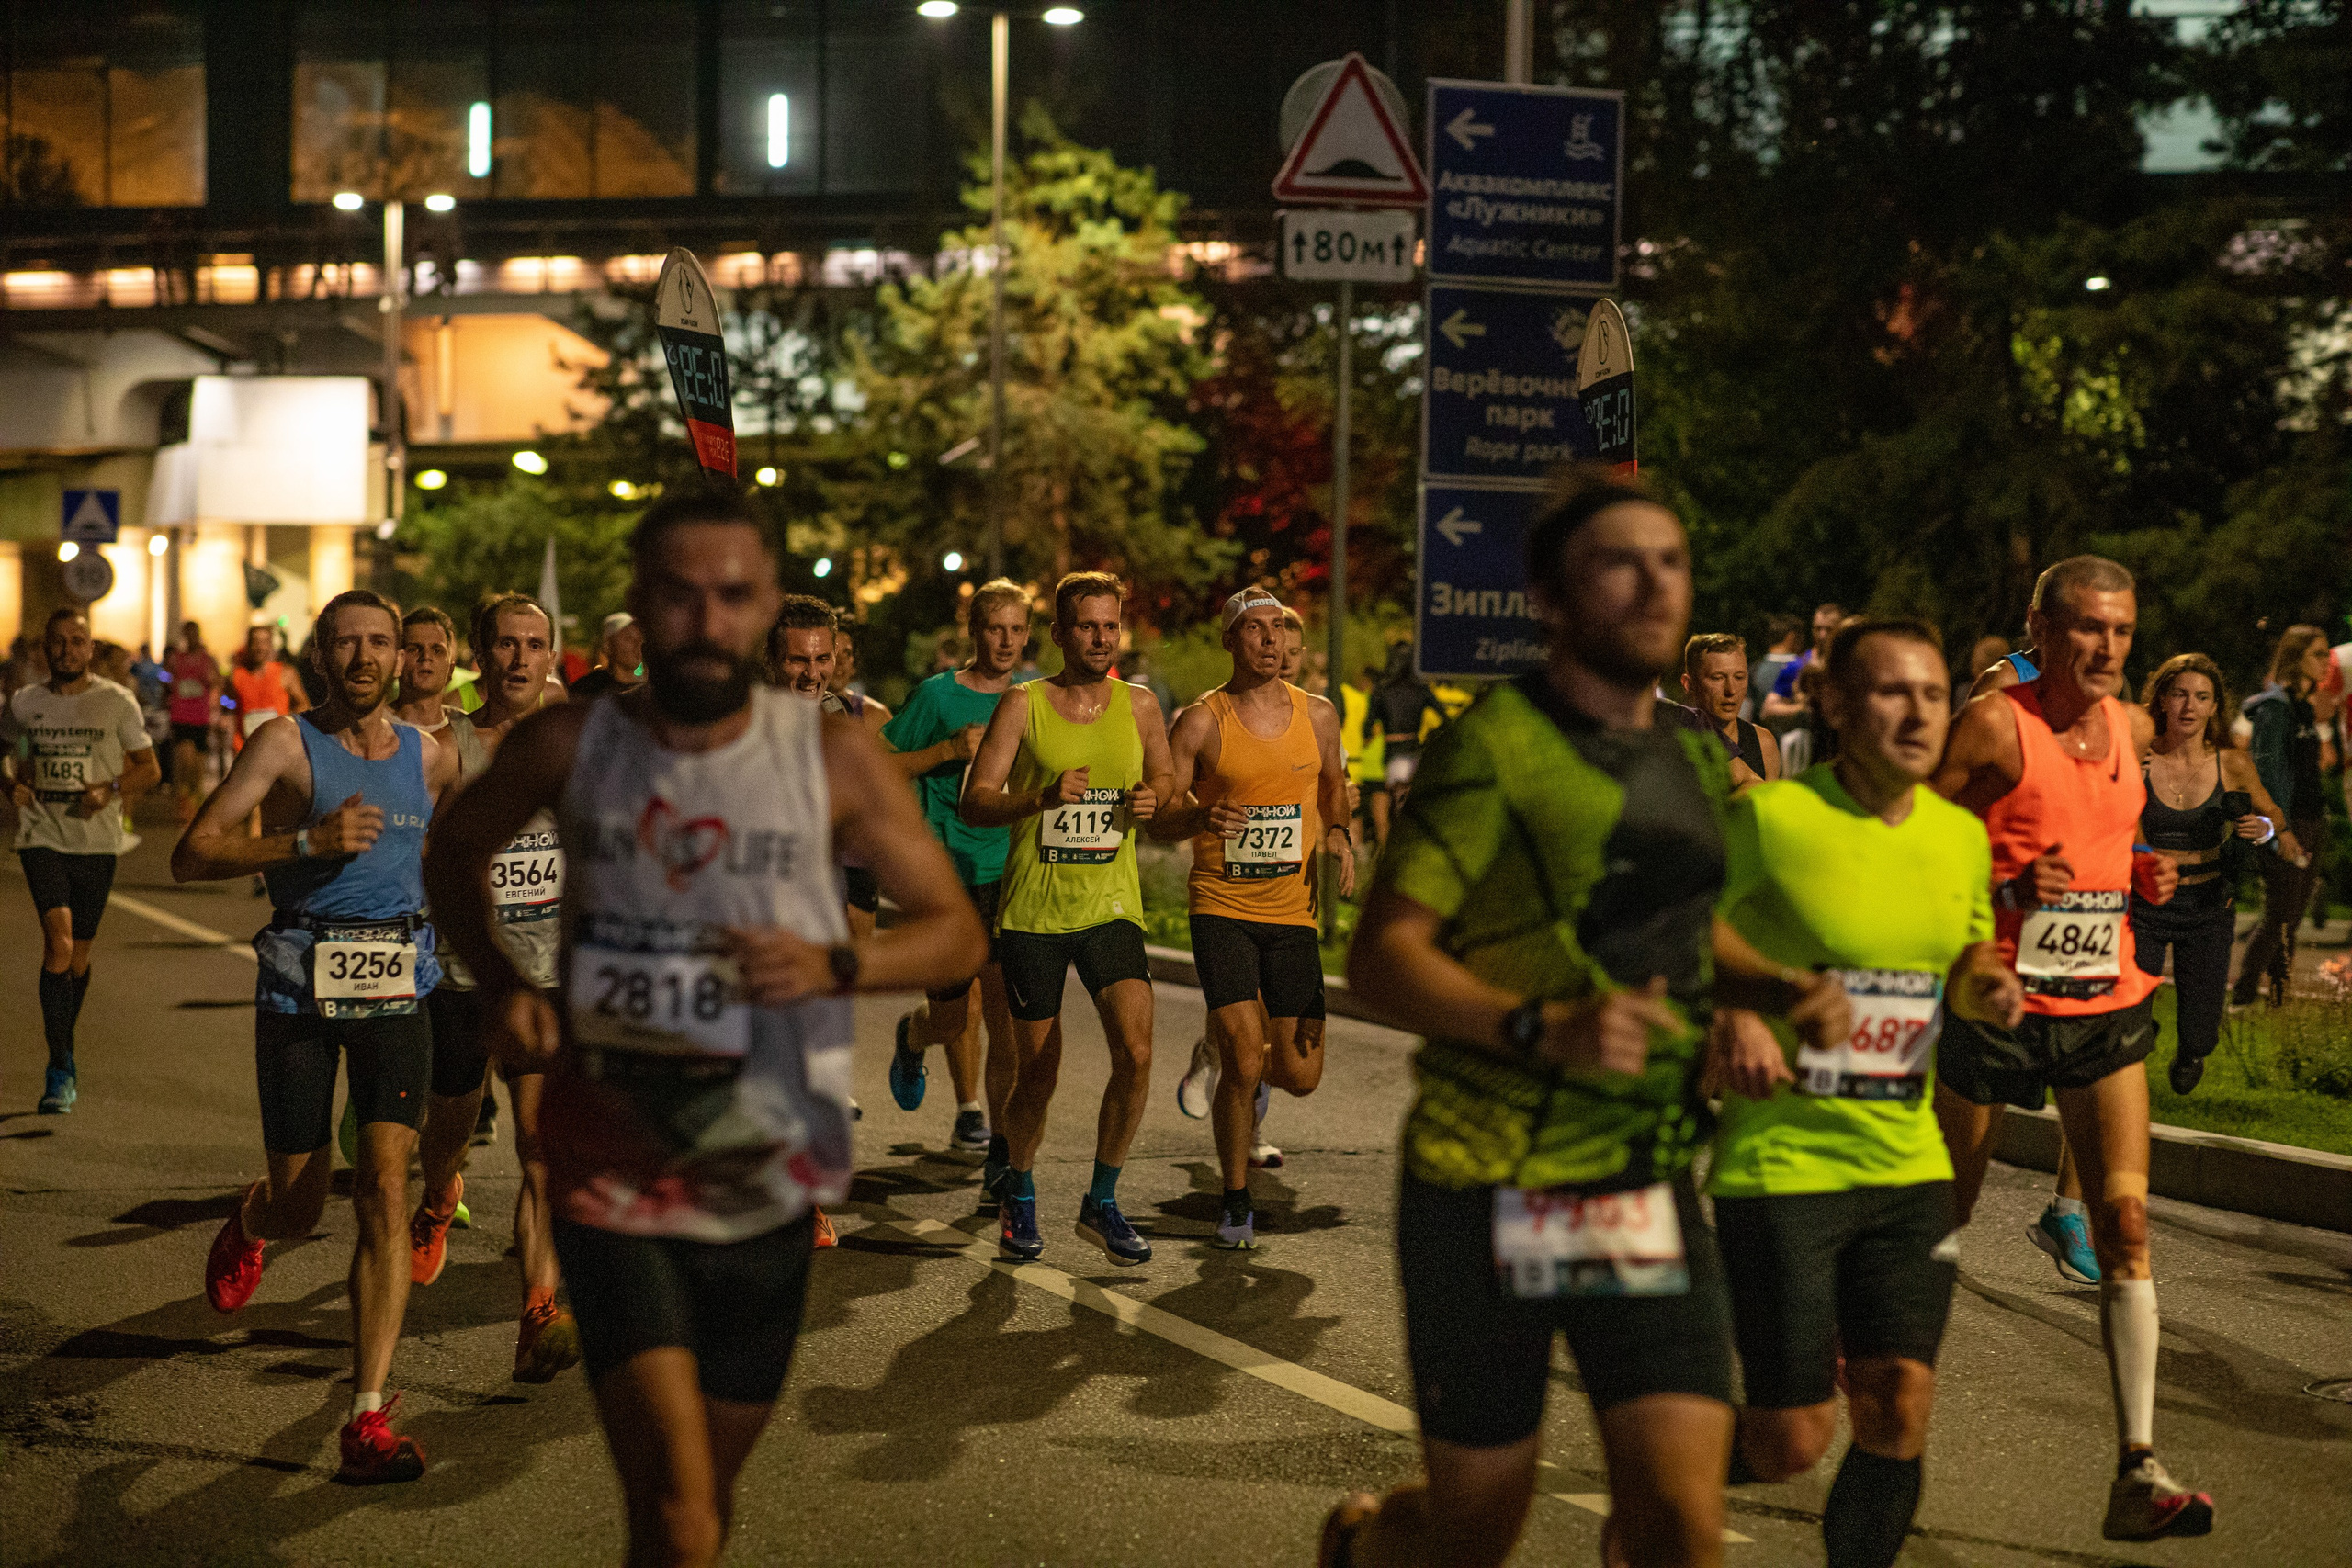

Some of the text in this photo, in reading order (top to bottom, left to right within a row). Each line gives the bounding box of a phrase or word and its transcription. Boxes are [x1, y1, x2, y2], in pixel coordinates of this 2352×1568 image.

[1486, 404, 1555, 434] парк
[41, 761, 85, 780] 1483
[1053, 810, 1114, 834] 4119
[1065, 834, 1100, 843] АЛЕКСЕЙ
[1235, 826, 1293, 849] 7372
[490, 857, 558, 888] 3564
[505, 886, 546, 898] ЕВГЕНИЙ
[2037, 922, 2113, 956] 4842
[329, 951, 402, 980] 3256
[354, 982, 379, 991] ИВАН
[594, 966, 726, 1022] 2818
